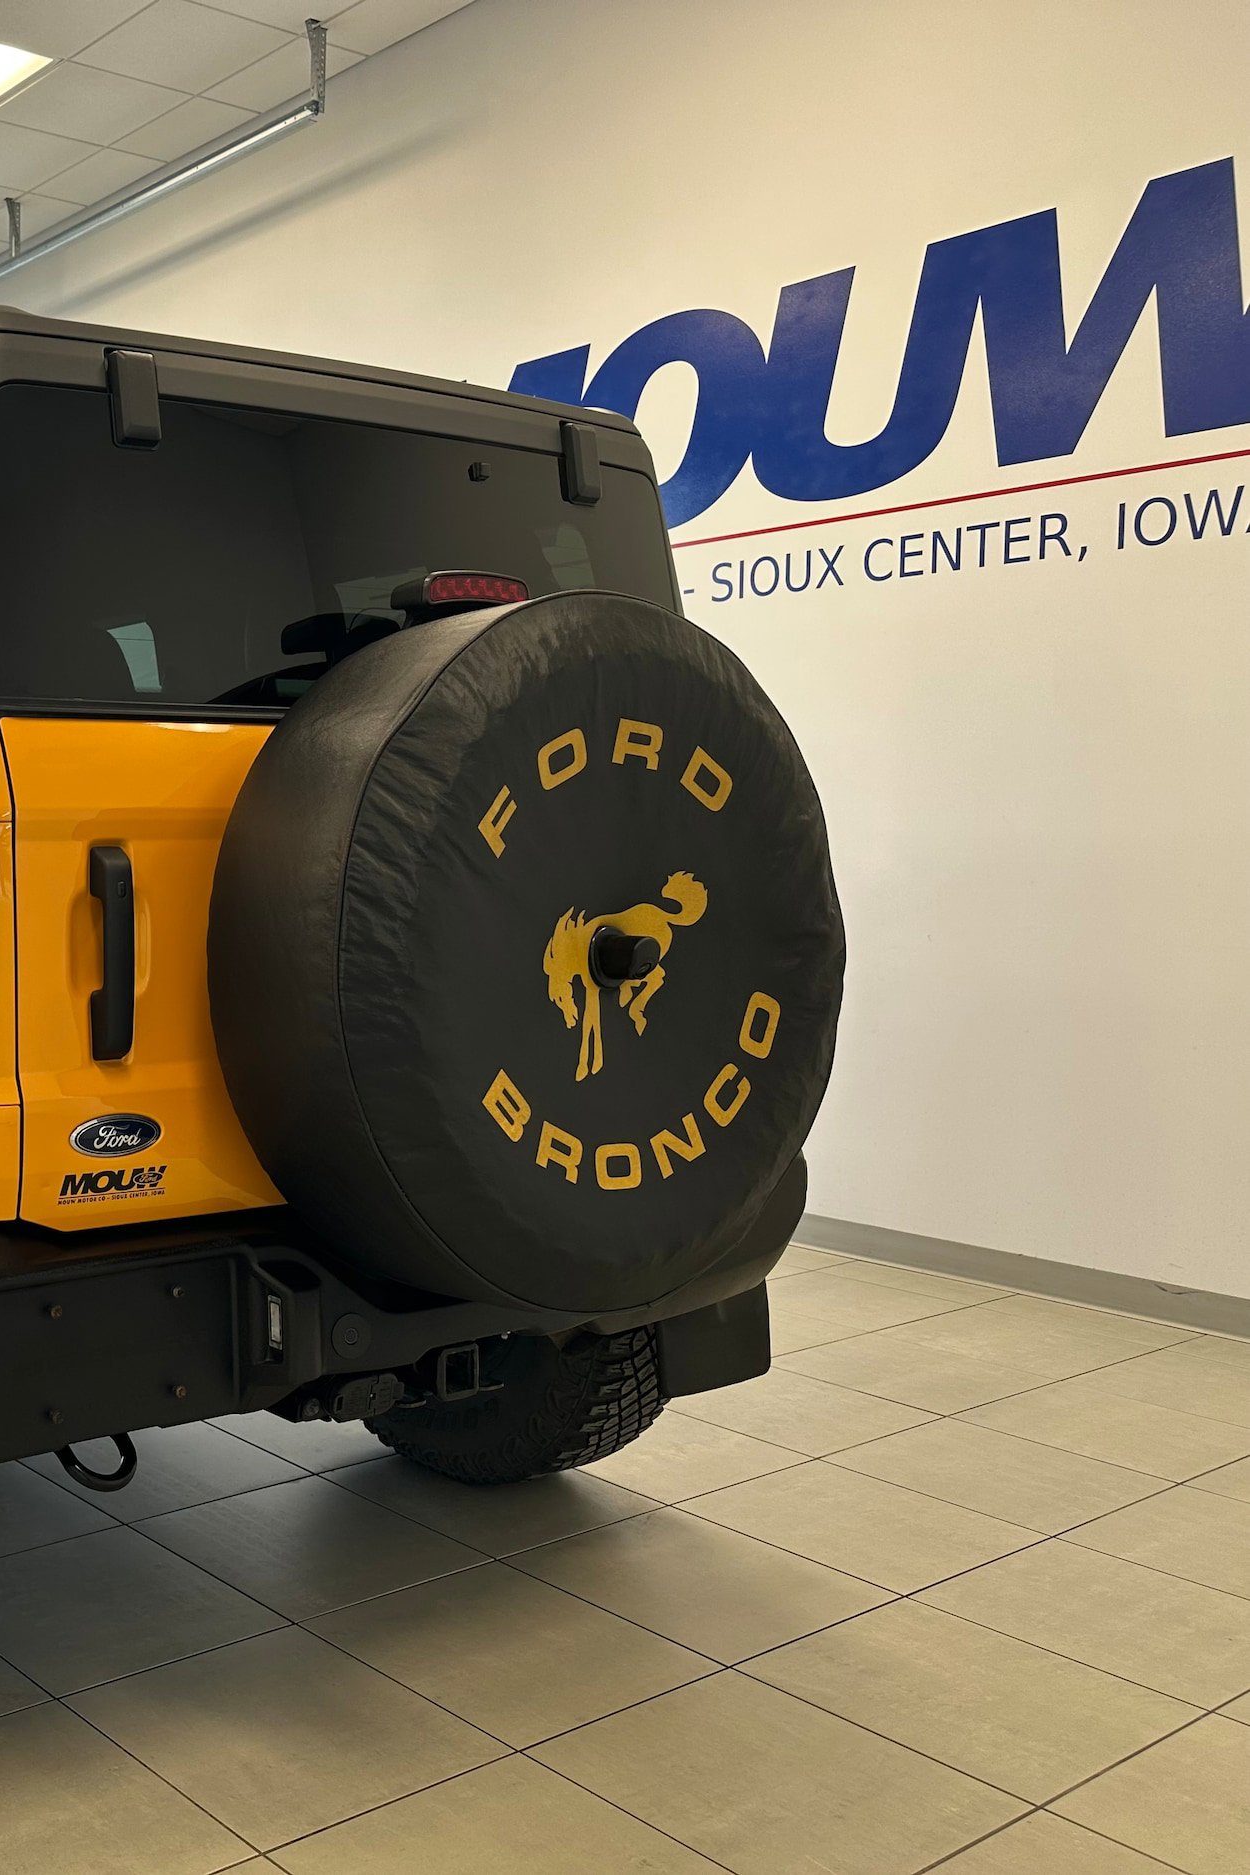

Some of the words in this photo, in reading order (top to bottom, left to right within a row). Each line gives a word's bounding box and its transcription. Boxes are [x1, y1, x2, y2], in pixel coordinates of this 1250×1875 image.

[507, 156, 1250, 532] OUW
[710, 544, 846, 603] SIOUX
[863, 512, 1089, 583] CENTER,
[1116, 484, 1250, 550] IOW
[478, 717, 733, 858] FORD
[93, 1124, 142, 1150] Ford
[481, 991, 781, 1191] BRONCO
